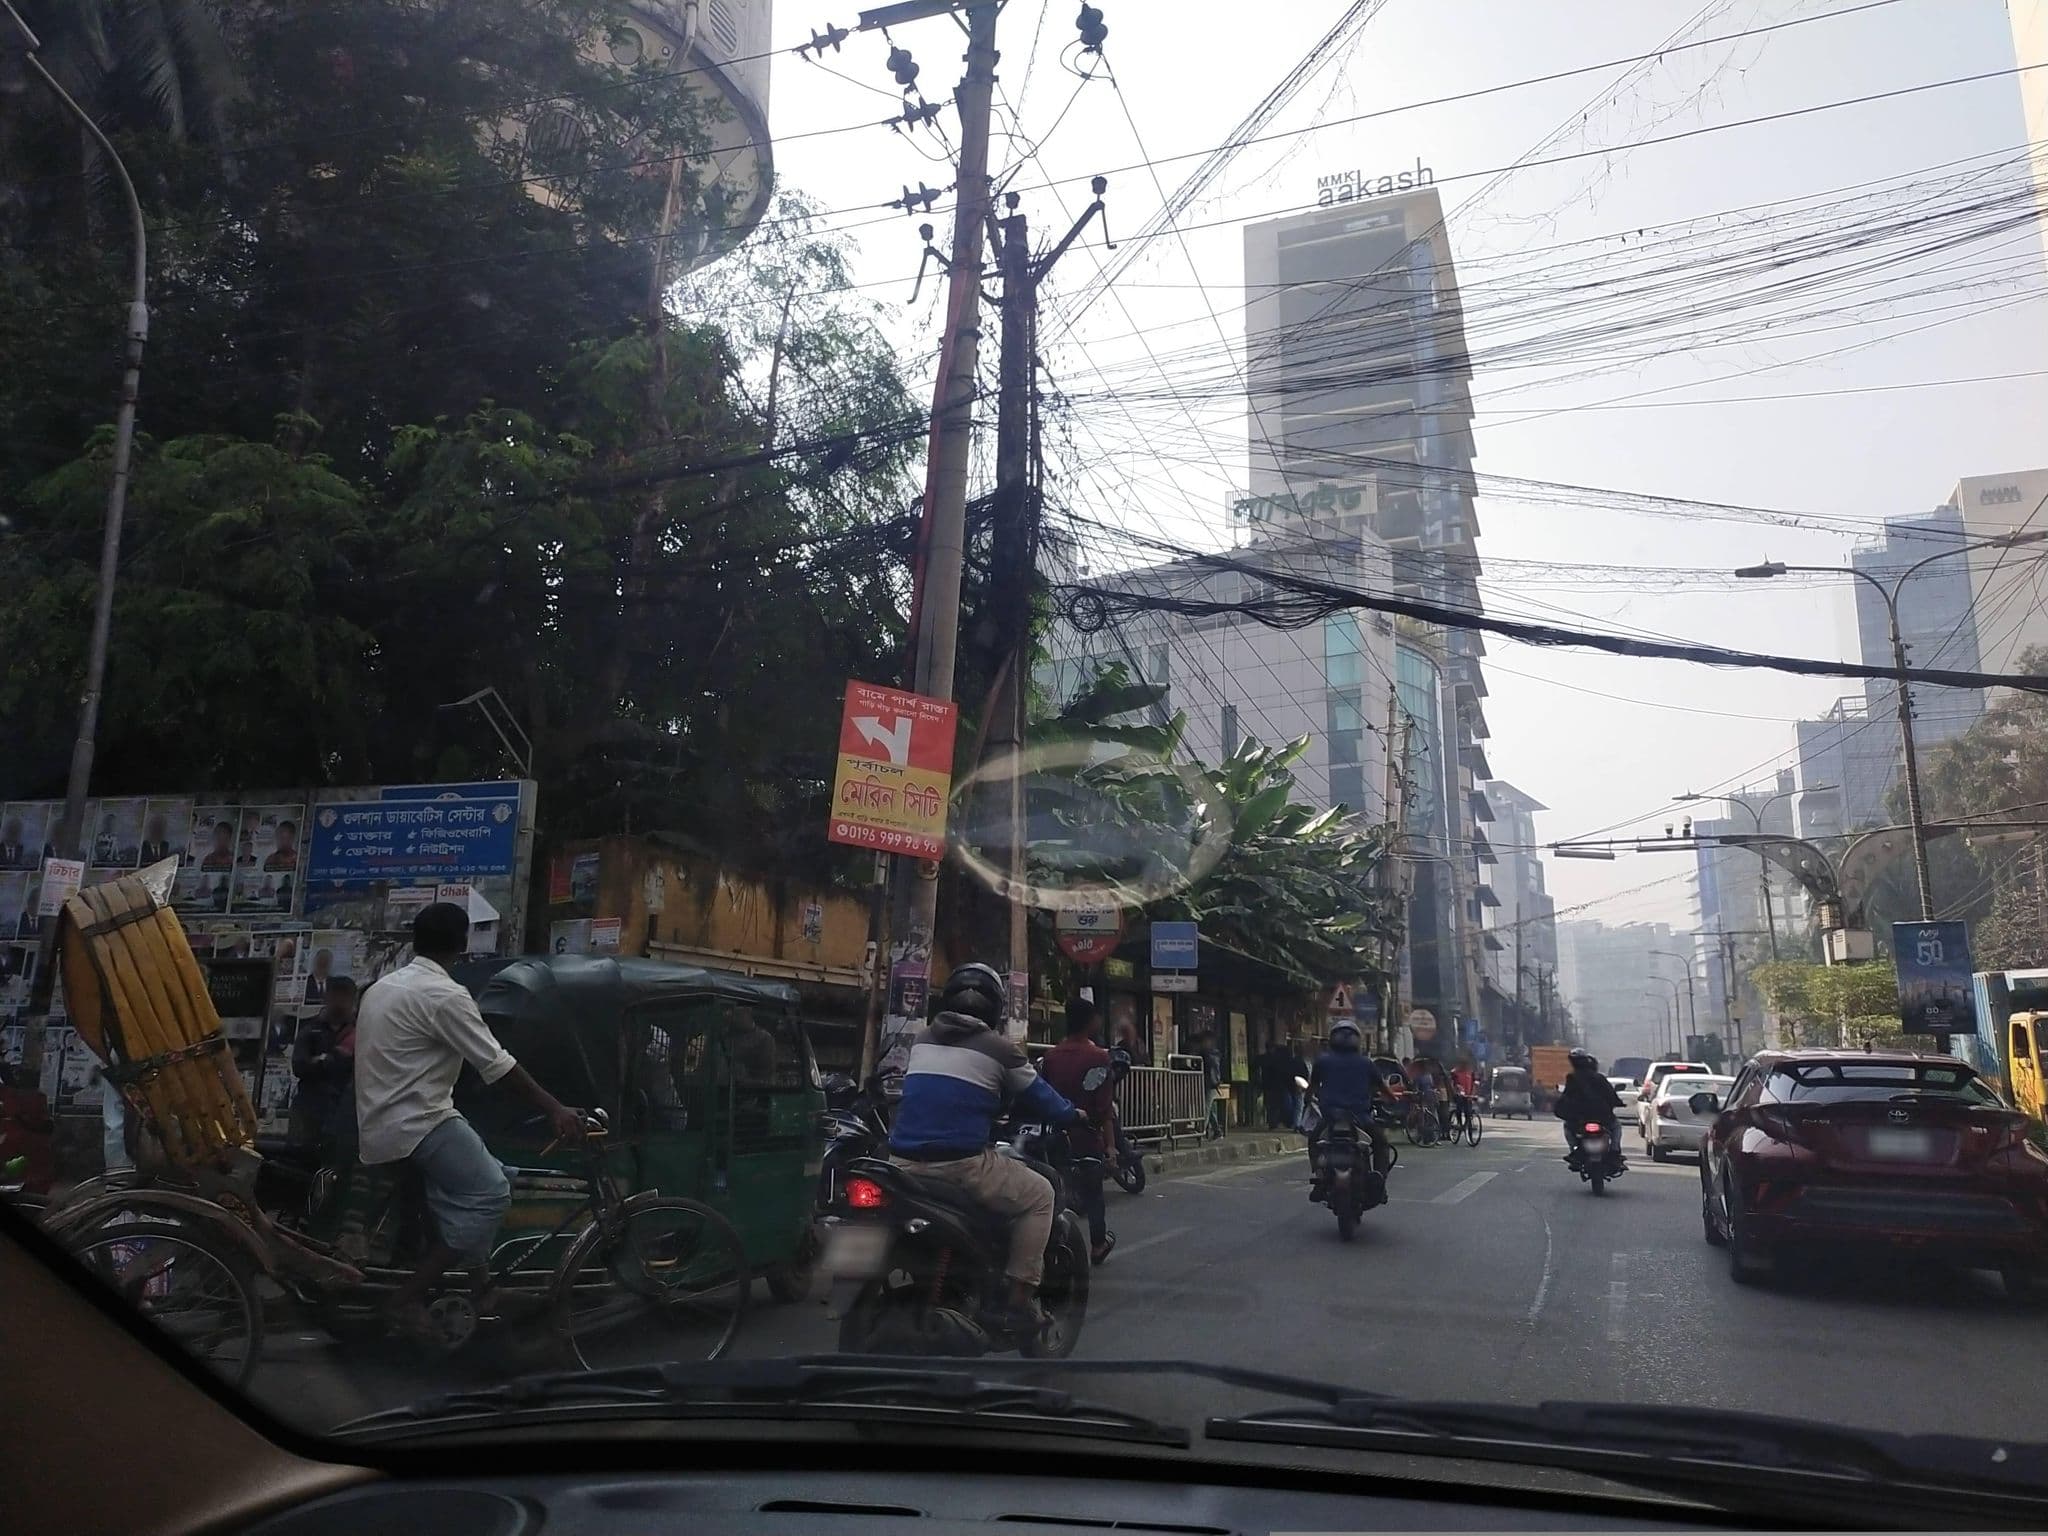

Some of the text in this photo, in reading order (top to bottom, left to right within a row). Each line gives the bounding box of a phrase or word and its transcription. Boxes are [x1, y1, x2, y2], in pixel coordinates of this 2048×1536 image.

[1317, 170, 1355, 188] MMK
[1318, 157, 1433, 207] aakash
[857, 686, 886, 701] বামে
[920, 700, 950, 715] রাস্তা
[846, 758, 905, 777] পূর্বাচল
[841, 774, 942, 818] মেরিন সিটি
[343, 806, 486, 828] গুলশান ডায়াবেটিস সেন্টার
[848, 825, 876, 842] 0196
[880, 831, 902, 847] 999
